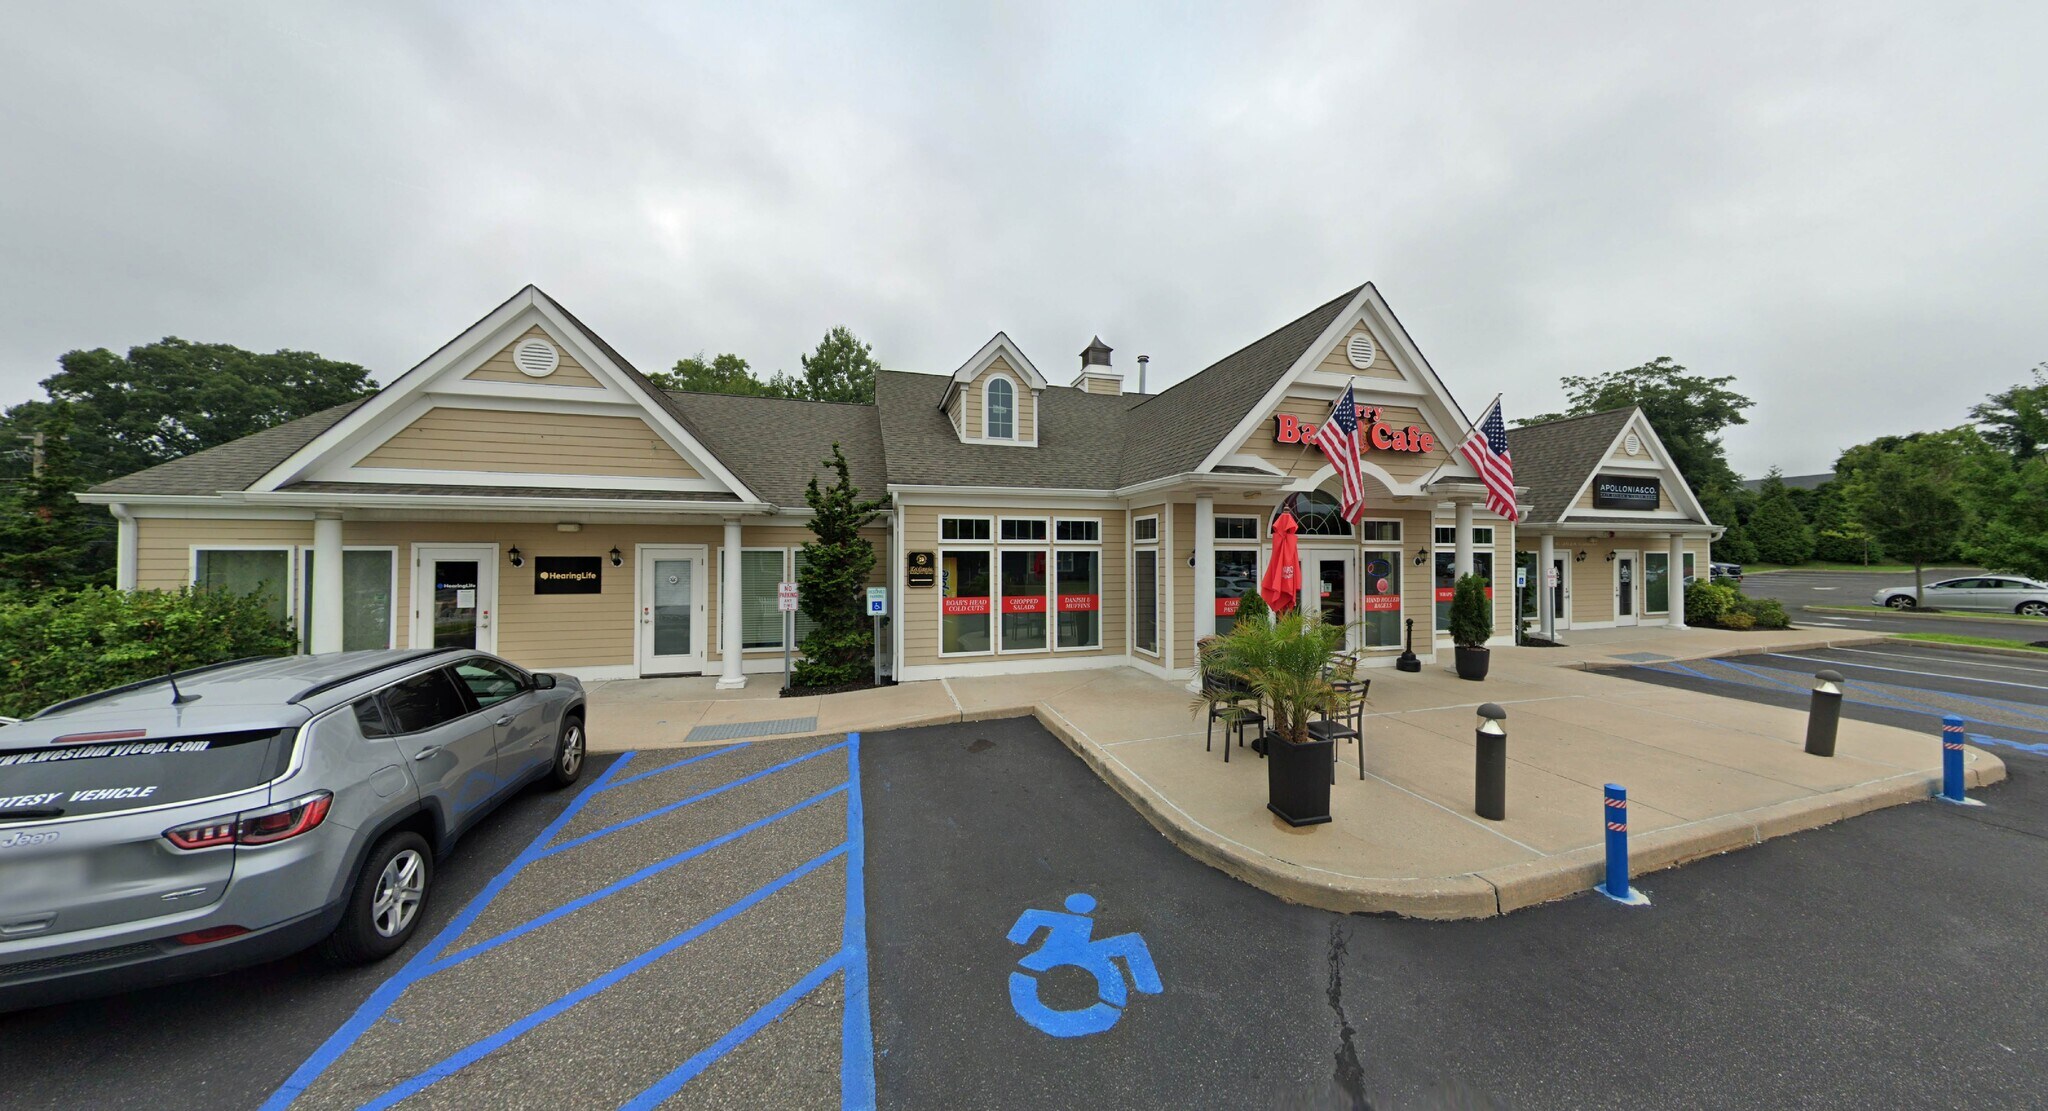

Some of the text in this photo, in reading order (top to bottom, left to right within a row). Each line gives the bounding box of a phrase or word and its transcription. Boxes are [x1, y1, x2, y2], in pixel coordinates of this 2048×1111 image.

[1371, 422, 1434, 453] Cafe
[1600, 484, 1657, 494] APOLLONIA&CO.
[549, 572, 597, 581] HearingLife
[68, 785, 158, 802] VEHICLE
[1, 831, 60, 849] Jeep
